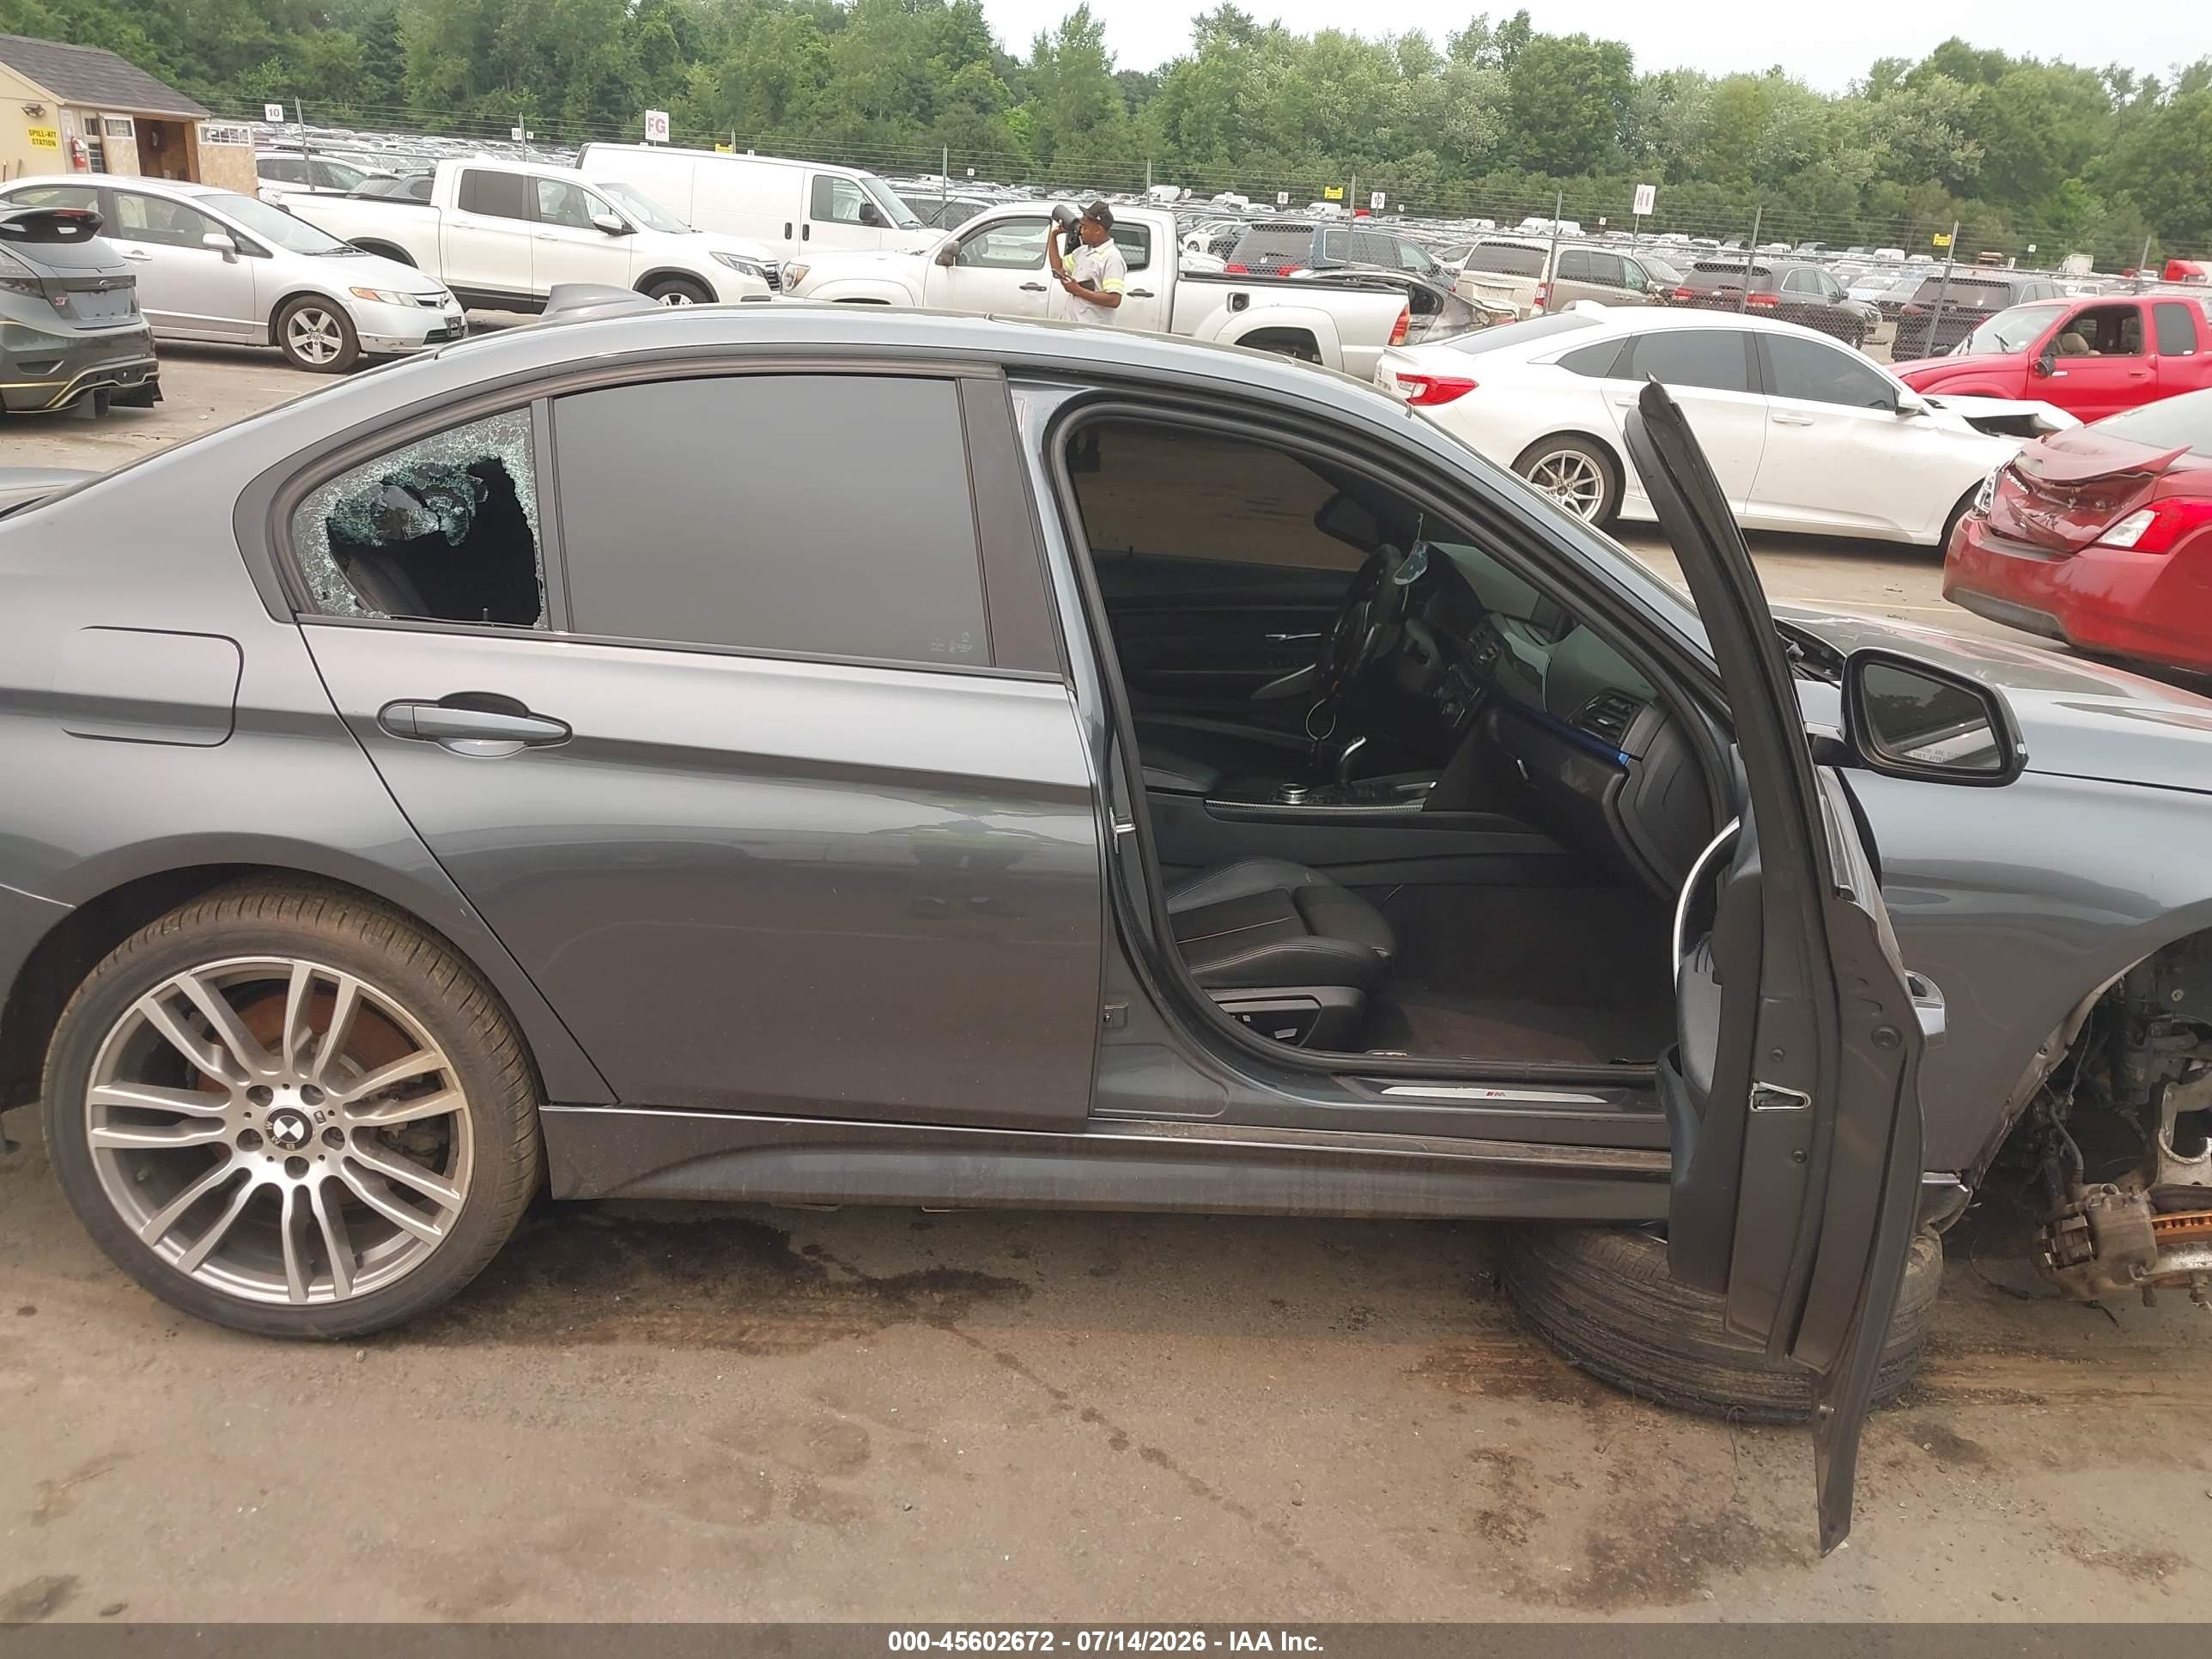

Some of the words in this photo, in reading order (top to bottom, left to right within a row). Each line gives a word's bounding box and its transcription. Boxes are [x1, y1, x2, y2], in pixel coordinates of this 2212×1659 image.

[268, 108, 280, 118] 10
[647, 117, 665, 134] FG
[28, 129, 57, 138] SPILL-KIT
[32, 138, 57, 148] STATION
